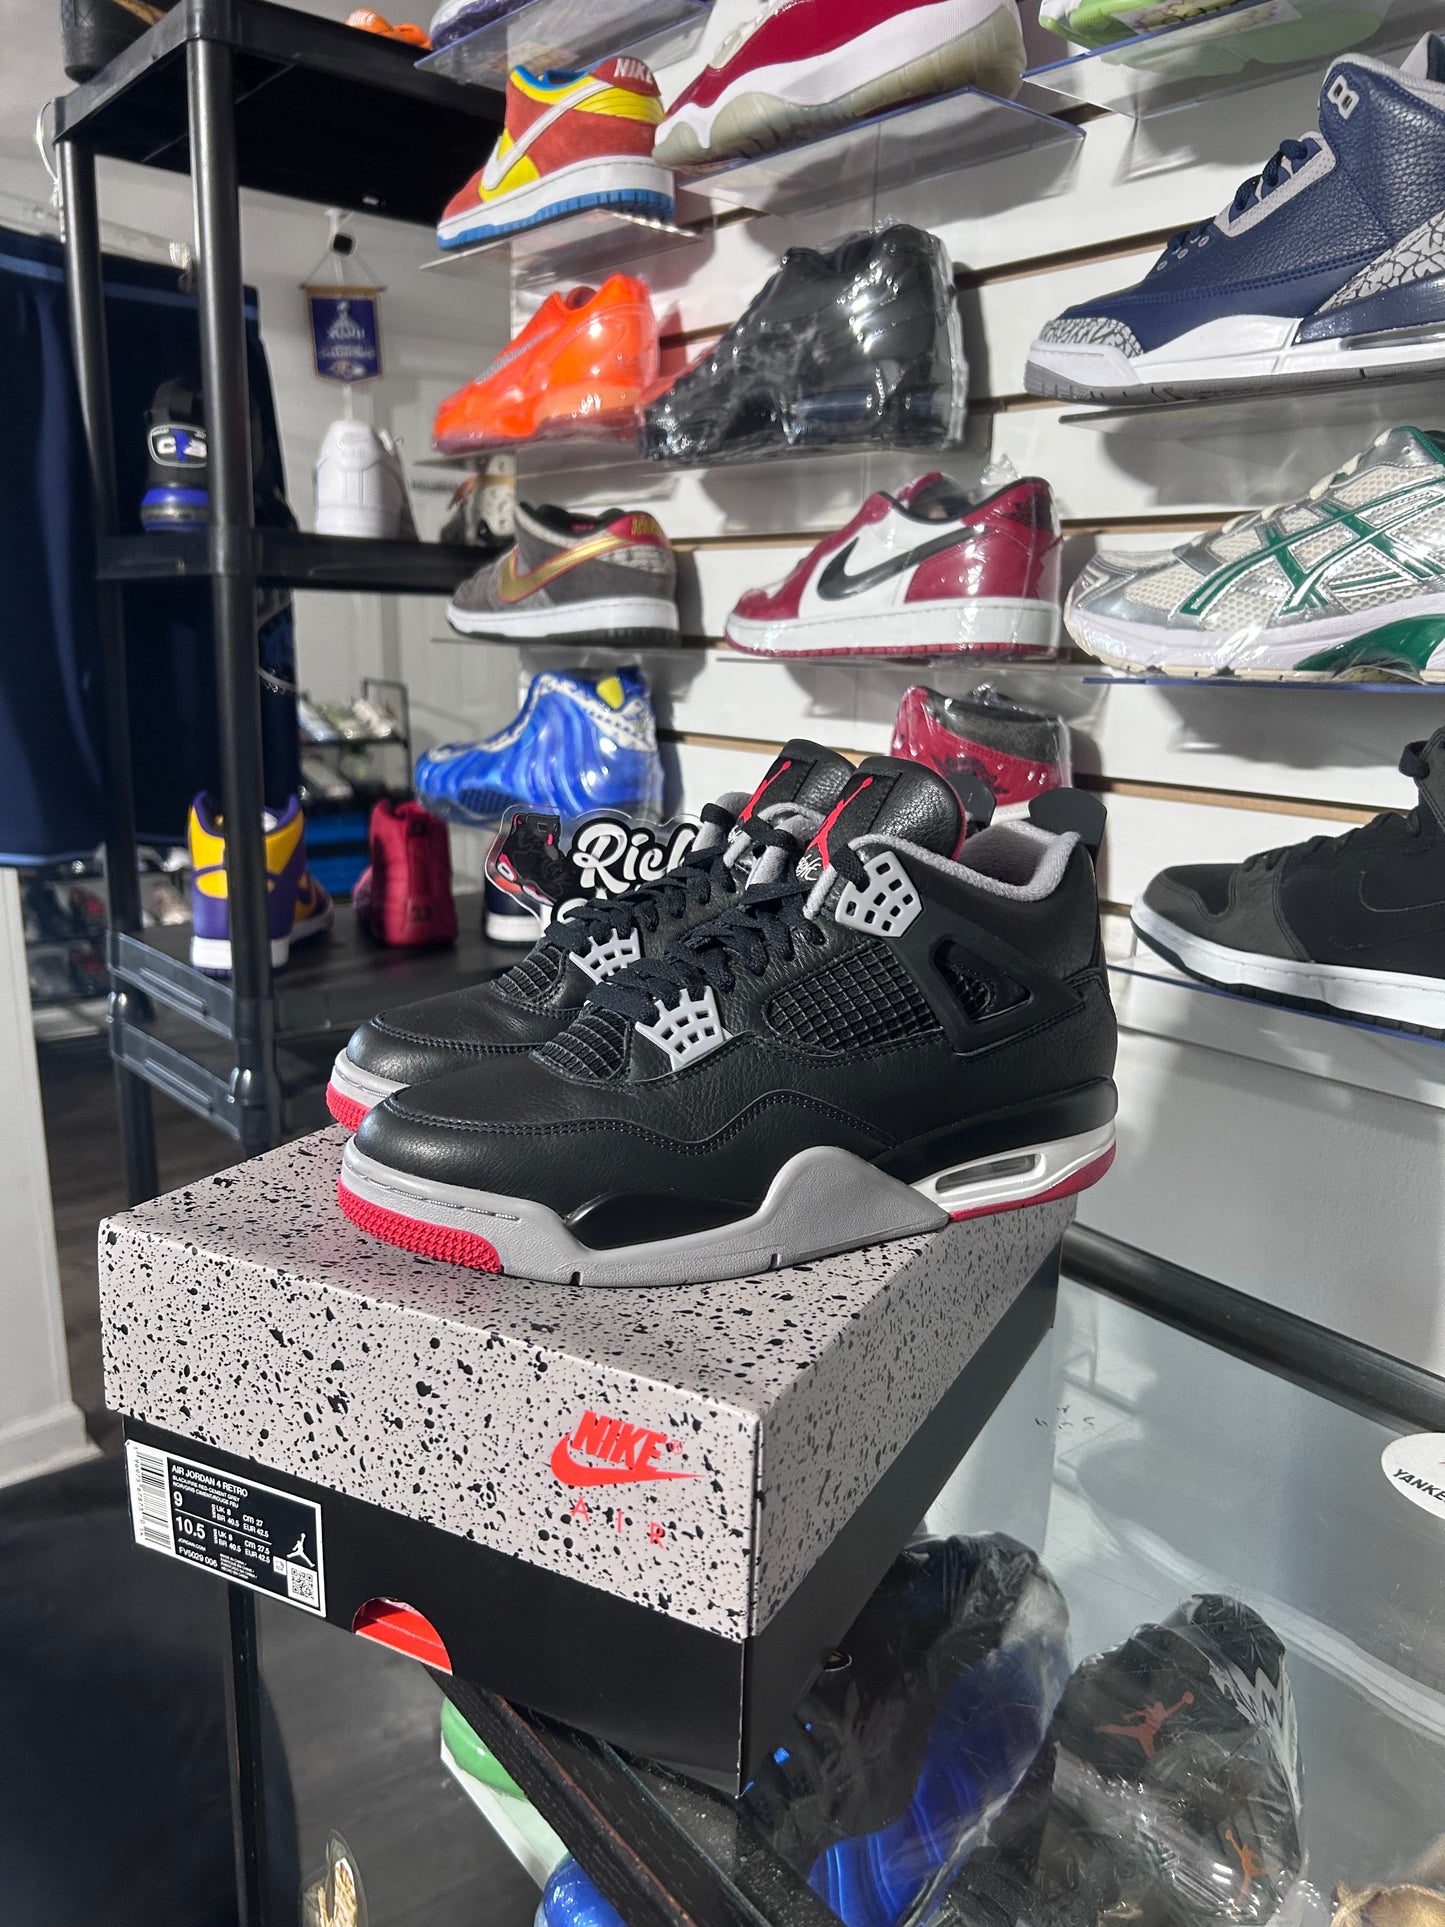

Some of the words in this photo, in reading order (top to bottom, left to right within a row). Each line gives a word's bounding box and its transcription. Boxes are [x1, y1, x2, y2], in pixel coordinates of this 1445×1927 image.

[613, 58, 653, 84] NIKE
[569, 1409, 669, 1473] NIKE
[172, 1464, 184, 1476] AIR
[185, 1469, 215, 1486] JORDAN
[216, 1479, 221, 1488] 4
[222, 1481, 248, 1498] RETRO
[173, 1490, 183, 1507] 9
[175, 1515, 206, 1540] 10.5
[216, 1504, 225, 1514] UK
[255, 1518, 263, 1527] 27
[227, 1517, 240, 1528] 40.5
[242, 1522, 256, 1533] EUR
[256, 1527, 269, 1538] 42.5
[571, 1496, 666, 1550] AIR
[178, 1546, 204, 1562] FV5029
[217, 1530, 227, 1539] UK
[257, 1544, 270, 1555] 27.5
[229, 1542, 241, 1553] 40.5
[244, 1548, 258, 1559] EUR
[258, 1553, 271, 1564] 42.5
